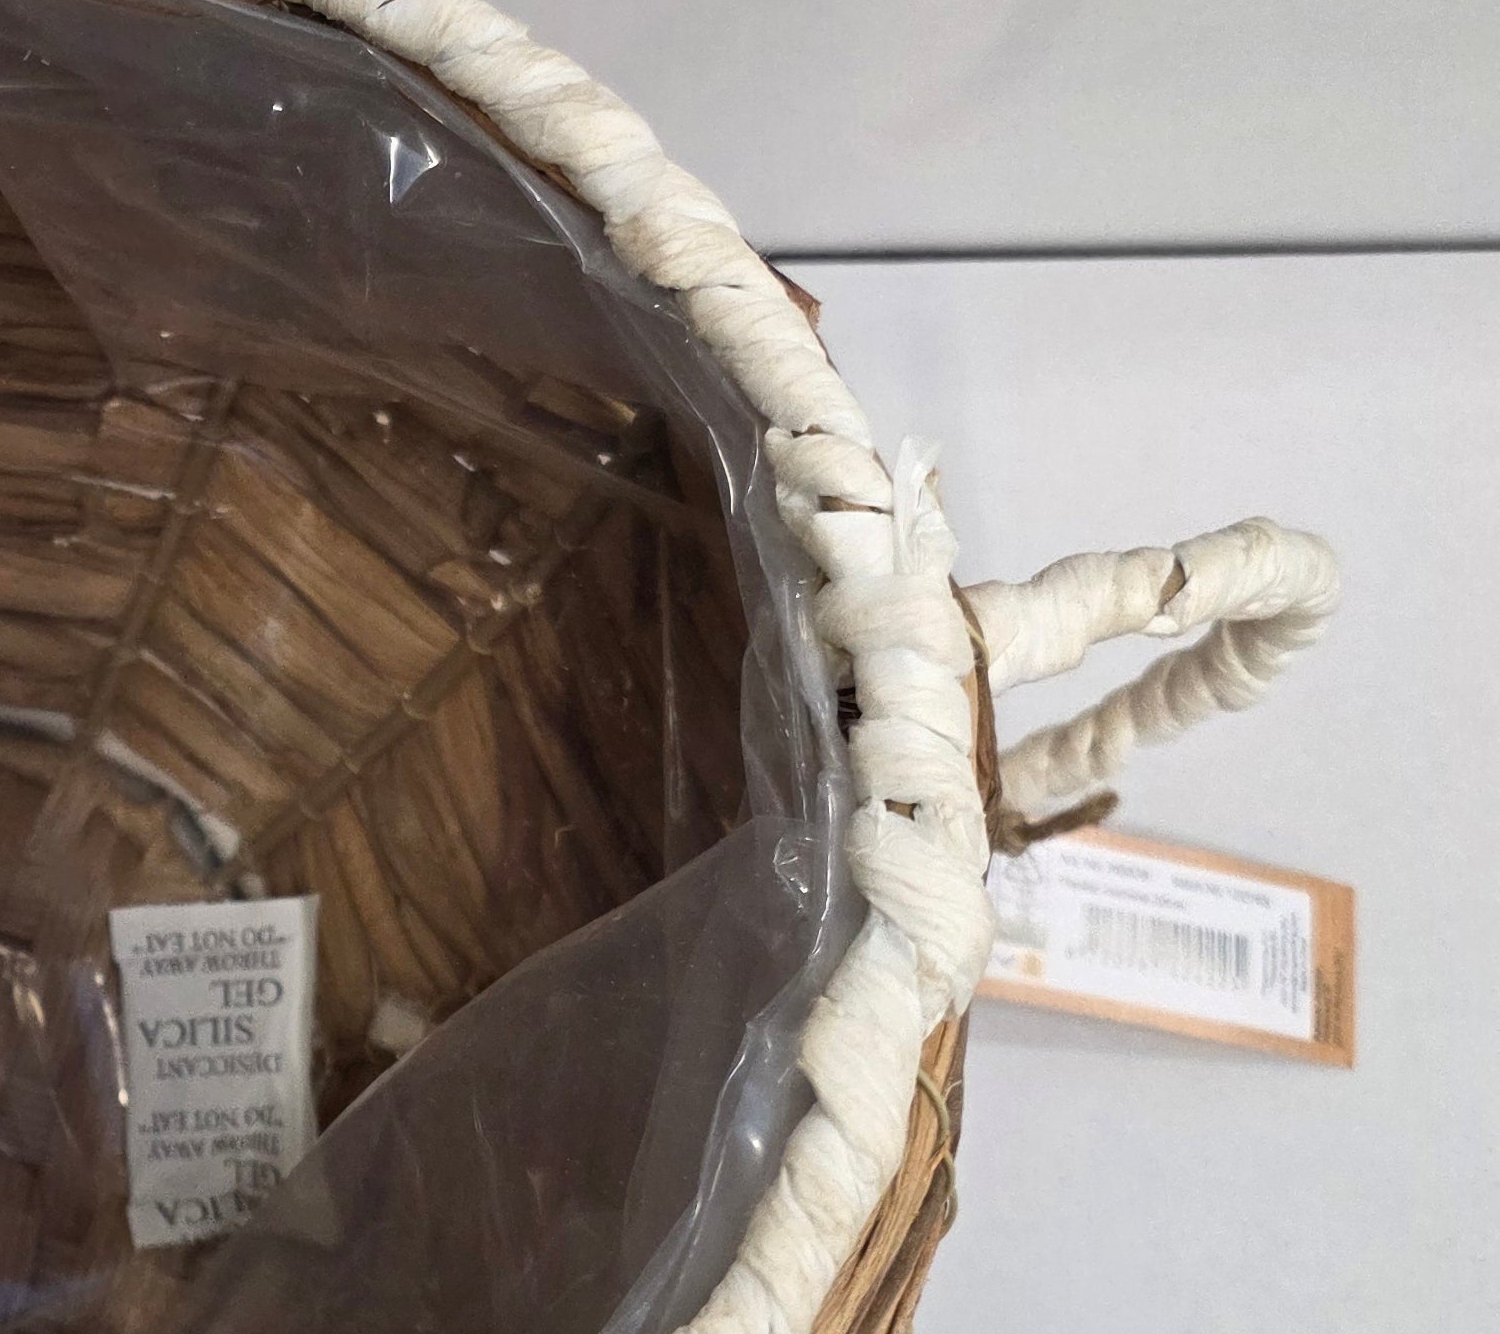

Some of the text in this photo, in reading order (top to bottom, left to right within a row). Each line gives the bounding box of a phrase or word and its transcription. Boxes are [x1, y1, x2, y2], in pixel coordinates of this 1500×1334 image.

[192, 929, 238, 952] NOT
[139, 950, 281, 979] THROW AWAY
[209, 977, 284, 1010] GEL
[138, 1013, 256, 1049] SILICA
[156, 1053, 284, 1081] DESICCANT
[147, 1138, 206, 1163] AWAY
